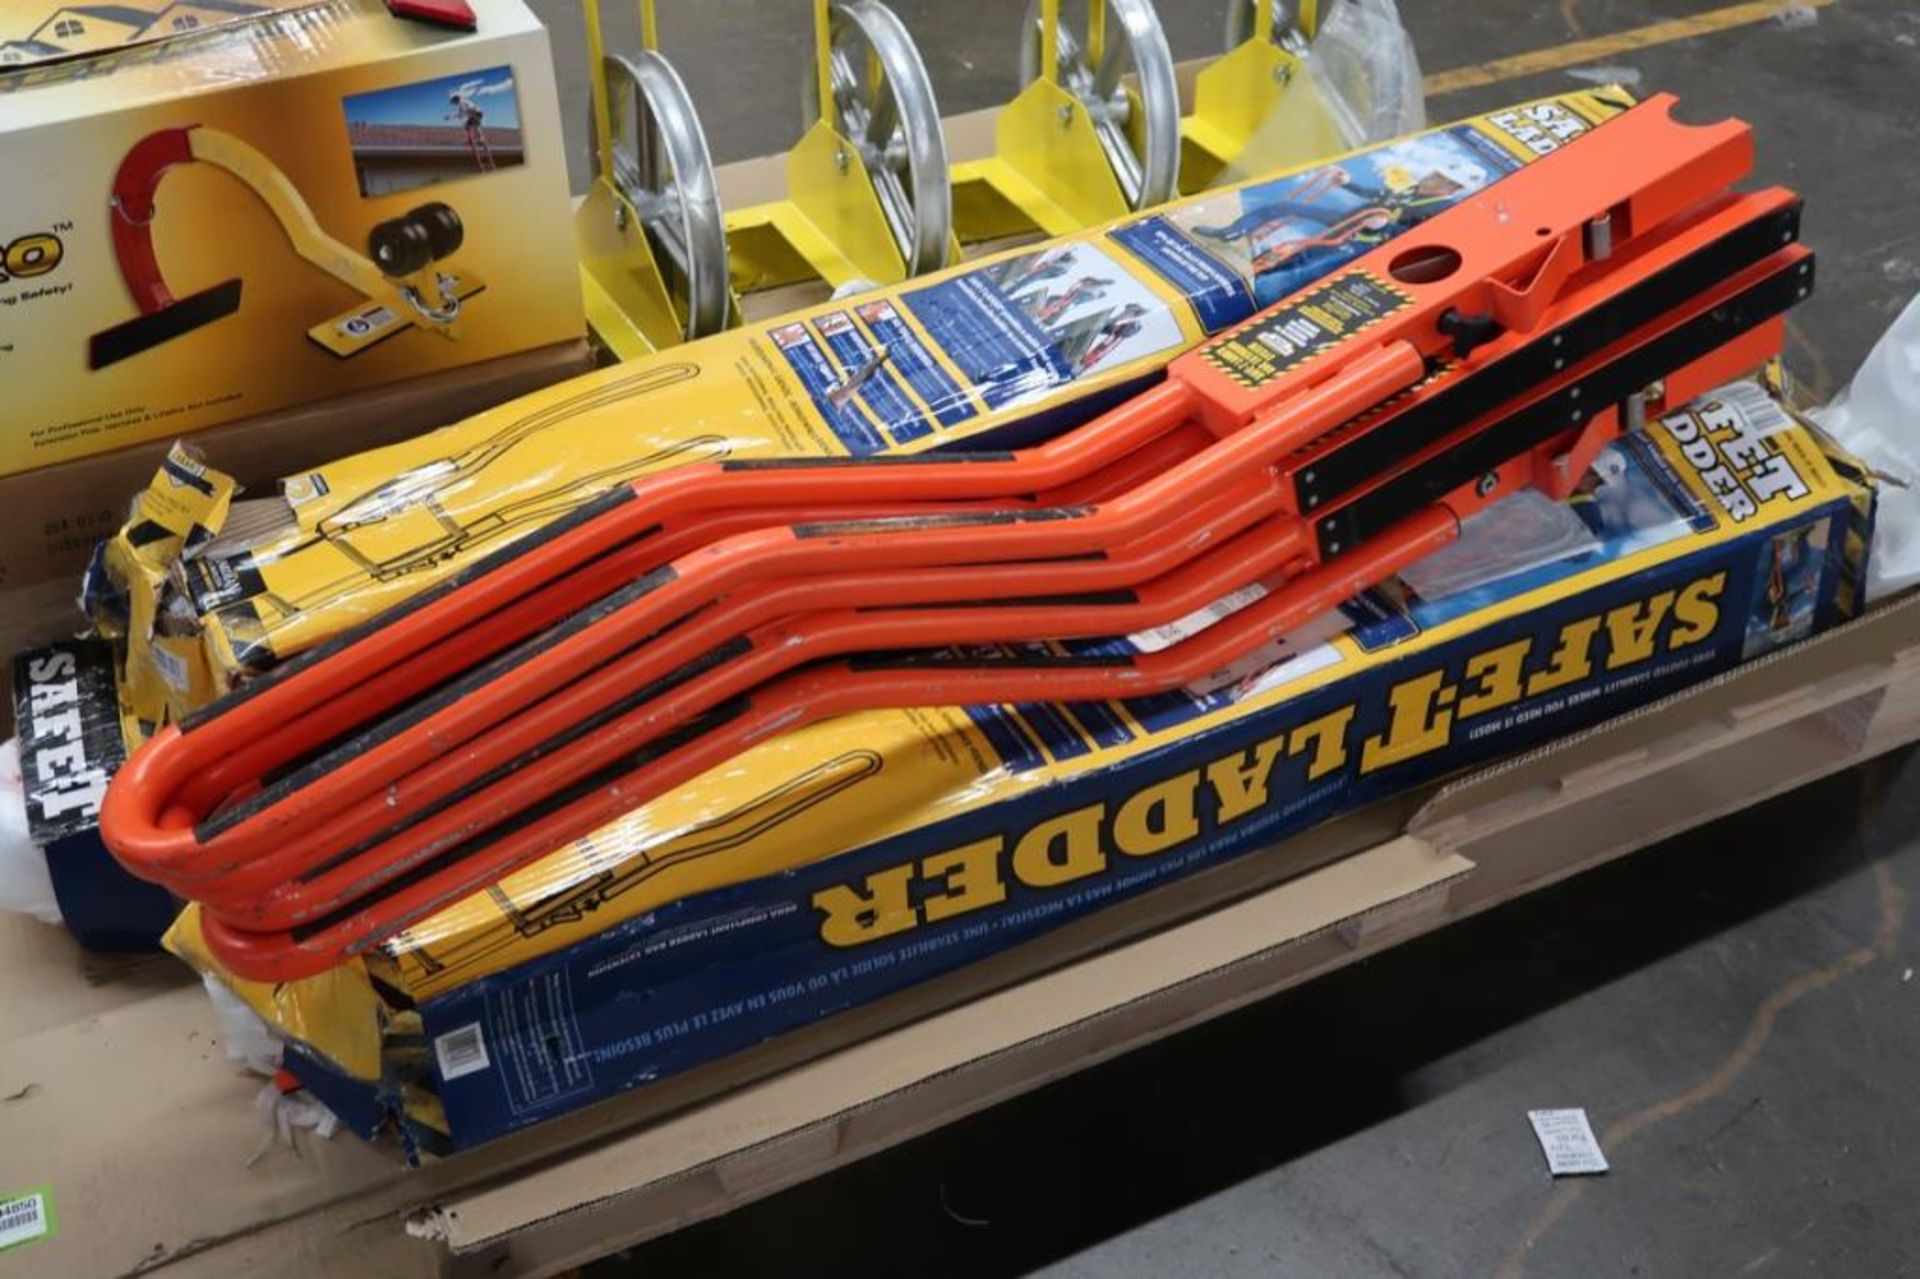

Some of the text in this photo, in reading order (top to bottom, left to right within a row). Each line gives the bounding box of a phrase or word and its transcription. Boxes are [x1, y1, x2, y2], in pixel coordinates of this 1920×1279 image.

[21, 281, 73, 301] Safety!
[47, 415, 103, 433] Professional
[1700, 400, 1812, 504] FE-T
[1660, 411, 1758, 523] DDER
[1544, 699, 1564, 713] YOU
[1567, 687, 1601, 705] WHERE
[1504, 717, 1514, 728] IT
[1515, 707, 1543, 723] NEED
[1468, 720, 1502, 739] MOST!
[810, 703, 1358, 951] LADDER
[851, 951, 895, 975] SOLIDE
[746, 994, 765, 1010] EN
[768, 981, 805, 1003] VOUS
[692, 1014, 707, 1028] LE
[709, 1001, 745, 1023] AVEZ
[653, 1020, 689, 1041] PLUS
[593, 1032, 652, 1063] BESOIN!
[0, 1197, 38, 1218] 4850
